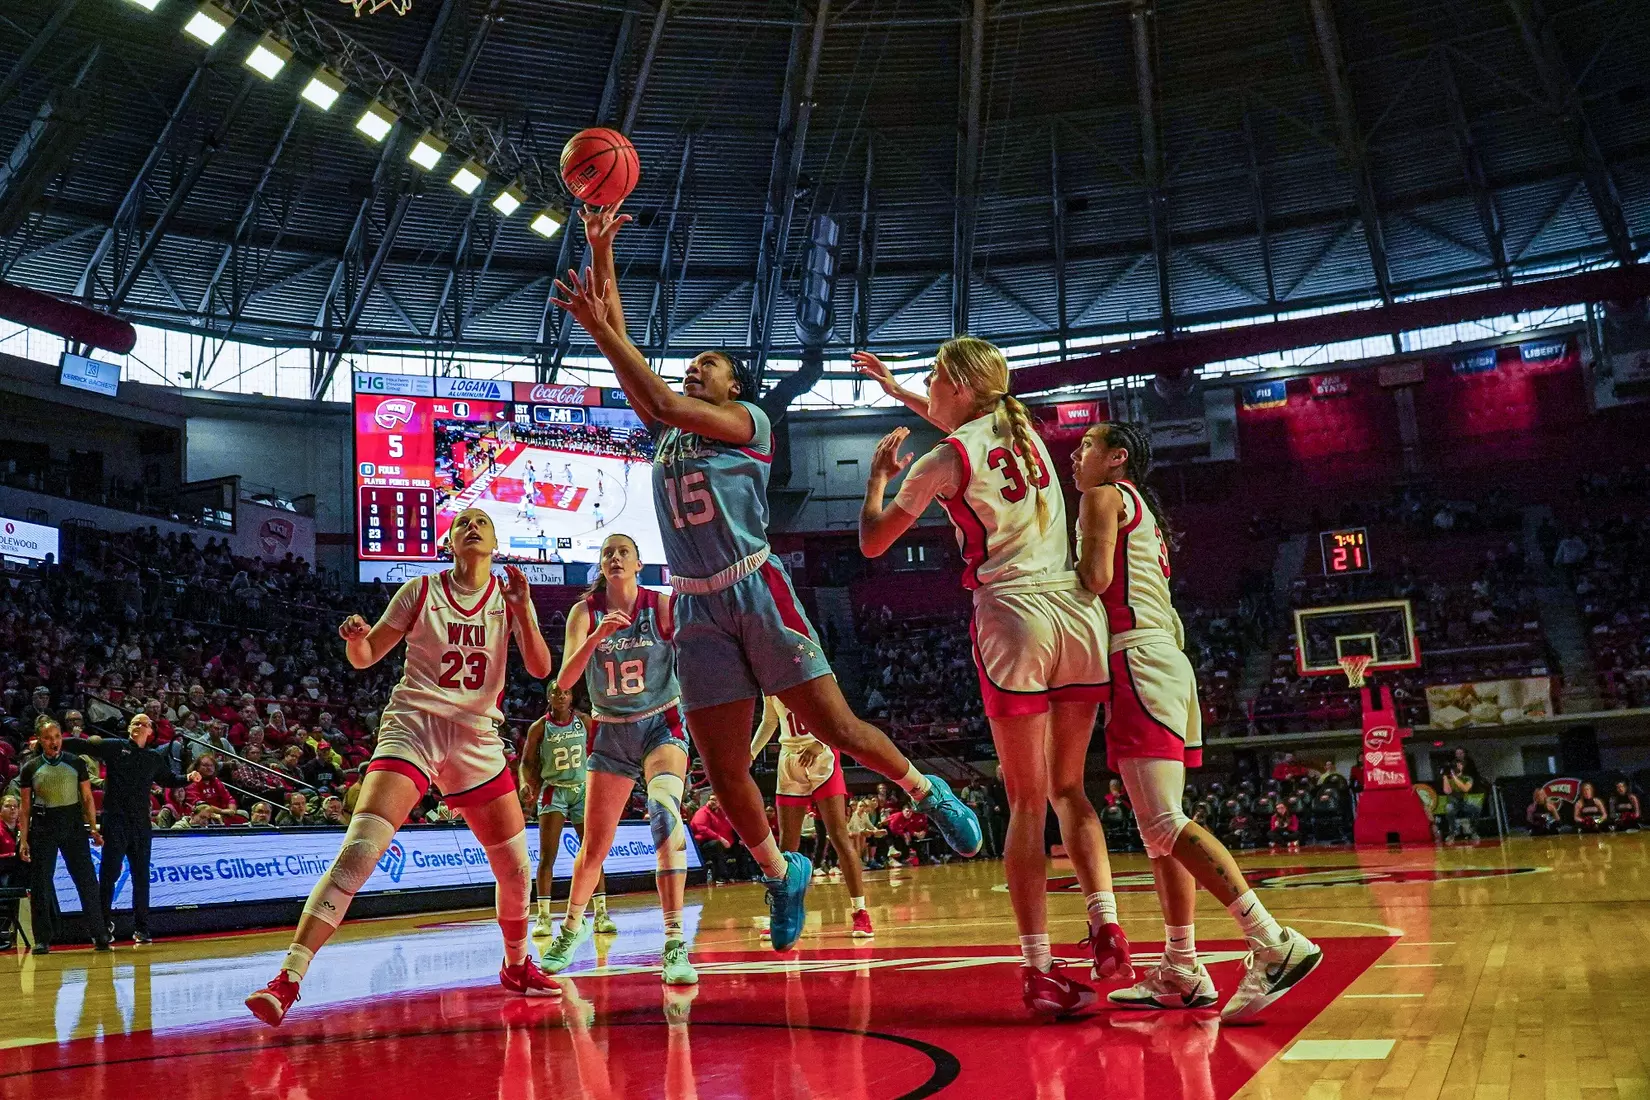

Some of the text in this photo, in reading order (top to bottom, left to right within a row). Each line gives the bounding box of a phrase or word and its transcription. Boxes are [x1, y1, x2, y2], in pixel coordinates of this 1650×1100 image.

[357, 376, 384, 390] HIG
[451, 380, 489, 392] LOGAN
[1256, 388, 1272, 398] FIU
[457, 403, 466, 416] 4
[515, 404, 528, 414] 1ST
[548, 408, 571, 422] 7:41
[1068, 410, 1089, 418] WKU
[388, 434, 404, 458] 5
[378, 465, 400, 475] FOULS
[388, 478, 410, 486] POINTS
[412, 479, 431, 487] FOULS
[371, 491, 427, 503] 1 0 0
[665, 472, 716, 529] 15
[370, 504, 427, 516] 3 0 0
[369, 516, 428, 528] 10 0 0
[267, 521, 288, 538] WKU
[368, 529, 428, 540] 23 0 0
[1334, 533, 1363, 546] 7:41
[368, 542, 428, 553] 33 0 0
[1333, 547, 1362, 570] 21
[531, 564, 544, 573] Are
[542, 574, 563, 584] Dairy
[447, 622, 486, 647] WKU
[438, 651, 488, 691] 23
[604, 659, 646, 697] 18
[552, 744, 583, 771] 22
[629, 841, 657, 856] Gilber
[412, 850, 463, 868] Graves
[215, 857, 284, 880] Gilbert
[285, 855, 330, 875] Clinic
